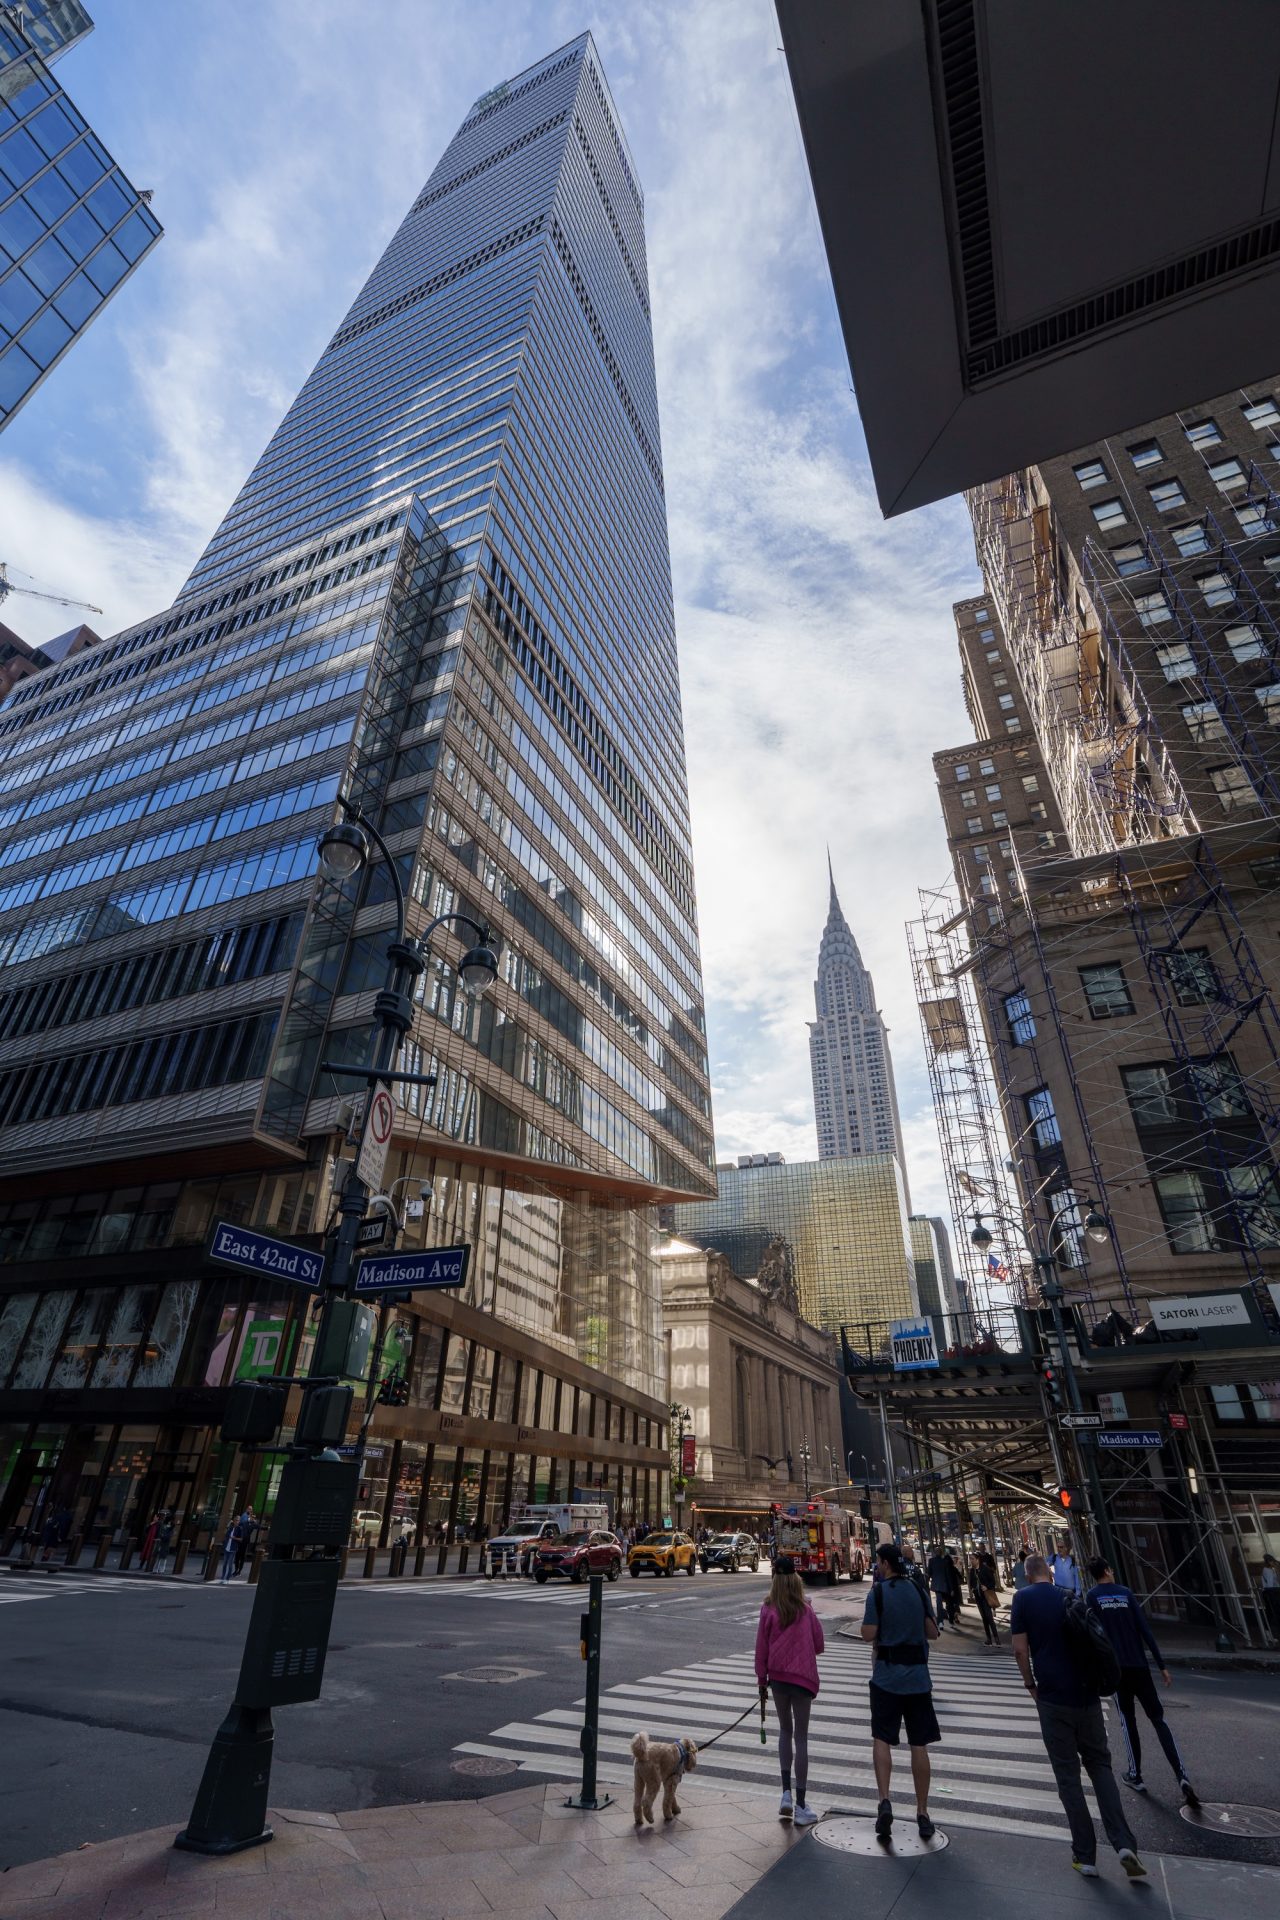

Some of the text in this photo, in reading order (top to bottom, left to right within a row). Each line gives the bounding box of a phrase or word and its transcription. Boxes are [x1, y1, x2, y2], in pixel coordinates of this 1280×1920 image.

[217, 1231, 318, 1279] East 42nd St
[358, 1260, 460, 1284] Madison Ave
[1159, 1308, 1199, 1320] SATORI
[251, 1331, 283, 1366] TD
[893, 1337, 936, 1363] PHOENIX
[1083, 1416, 1097, 1424] WAY
[1098, 1434, 1160, 1445] Madison Ave
[793, 1556, 802, 1565] 21
[1100, 1600, 1129, 1610] patagonia
